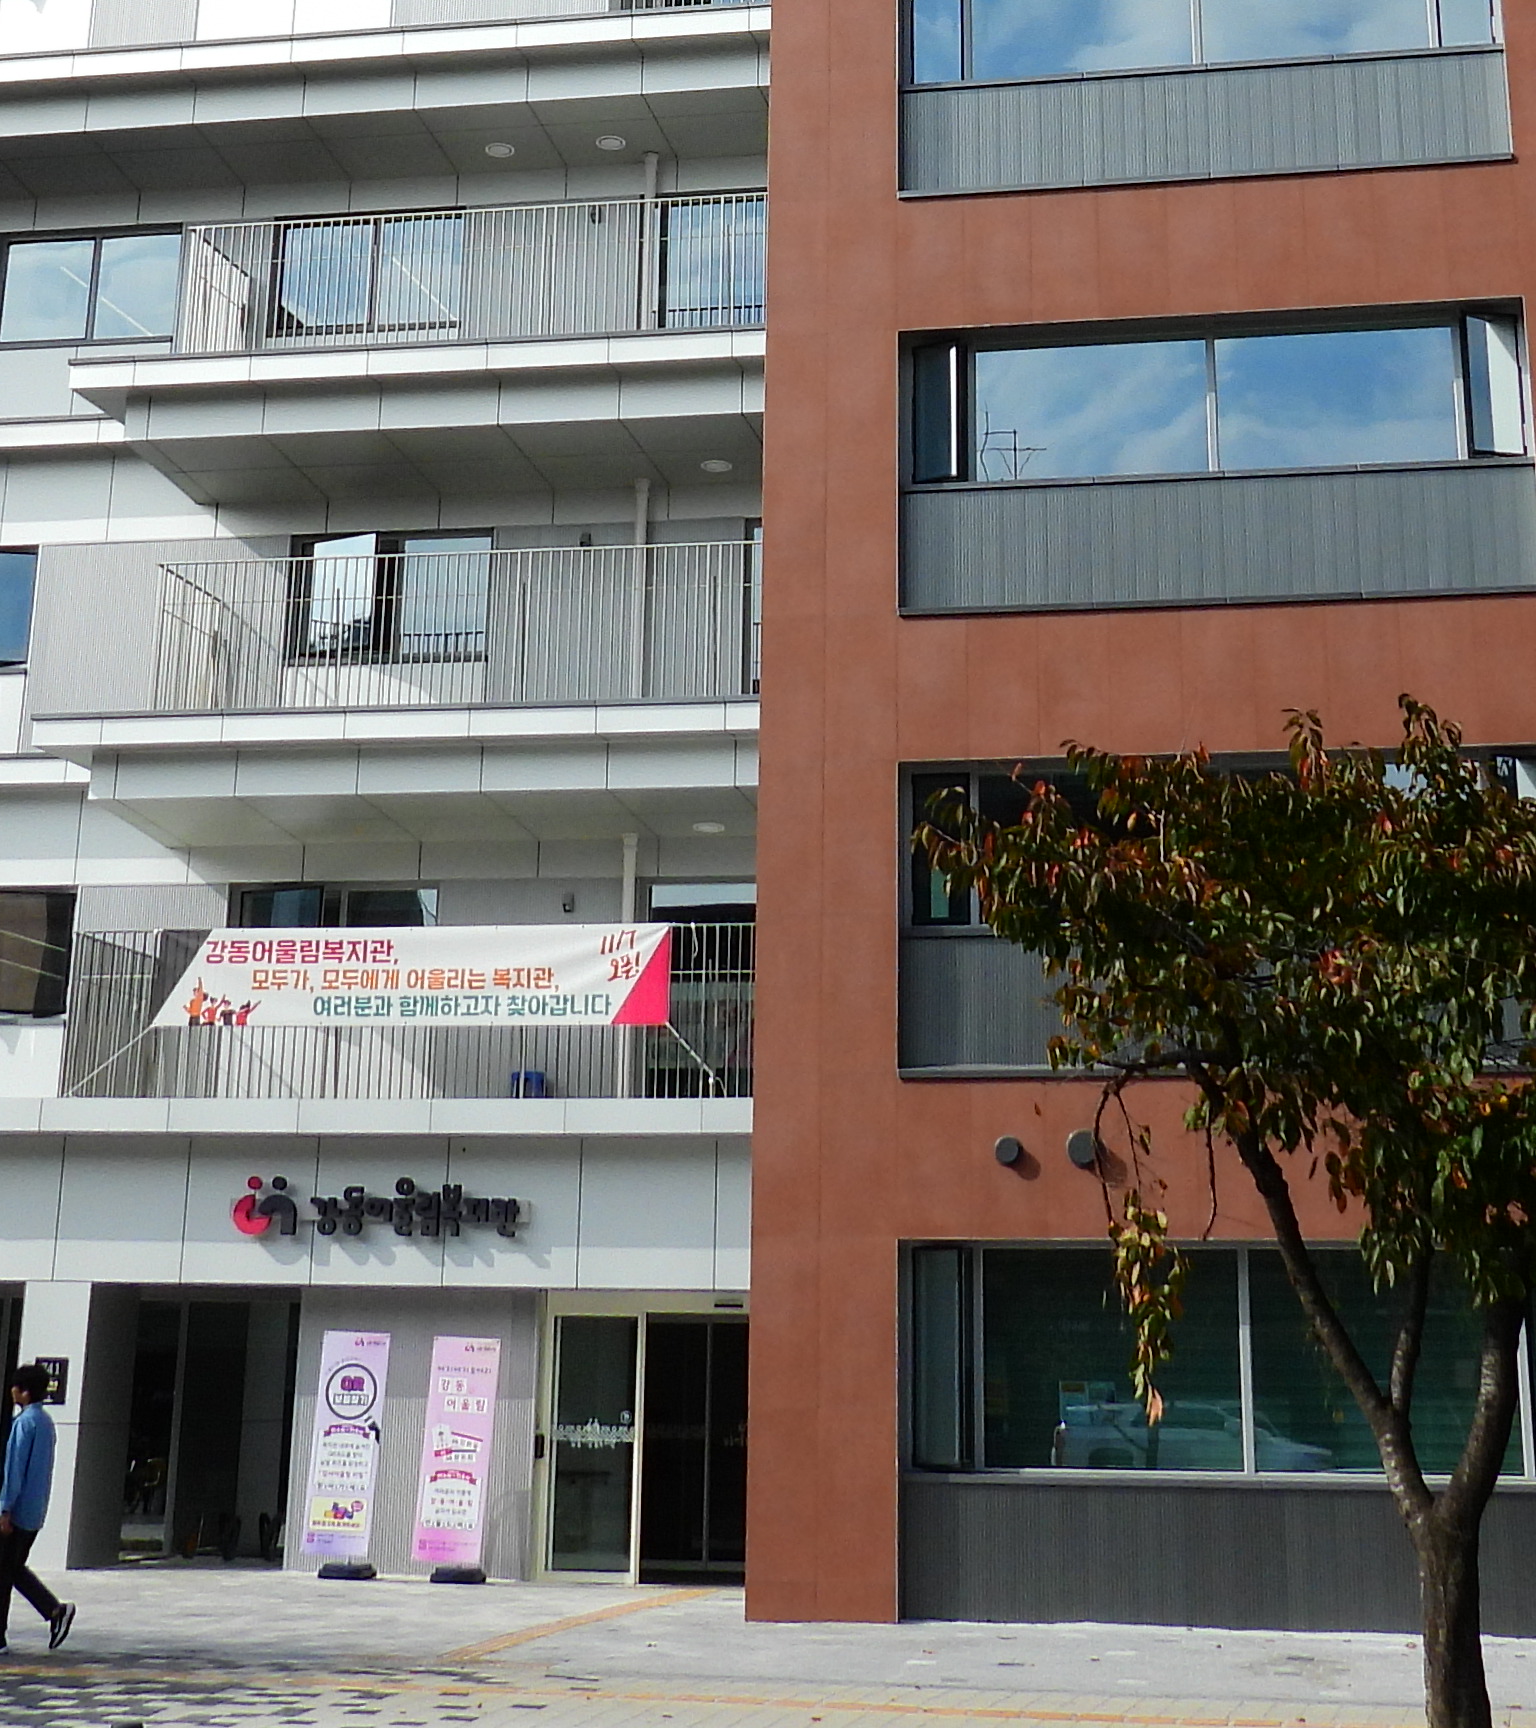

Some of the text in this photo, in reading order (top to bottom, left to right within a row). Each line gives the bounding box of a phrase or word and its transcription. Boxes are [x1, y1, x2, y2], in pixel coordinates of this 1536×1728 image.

[205, 939, 399, 965] 강동어울림복지관,
[600, 929, 638, 955] 11/7
[251, 967, 560, 993] 모두가, 모두에게 어울리는 복지관,
[314, 993, 613, 1018] 여러분과 함께하고자 찾아갑니다
[310, 1176, 521, 1238] 강동어울림복지관
